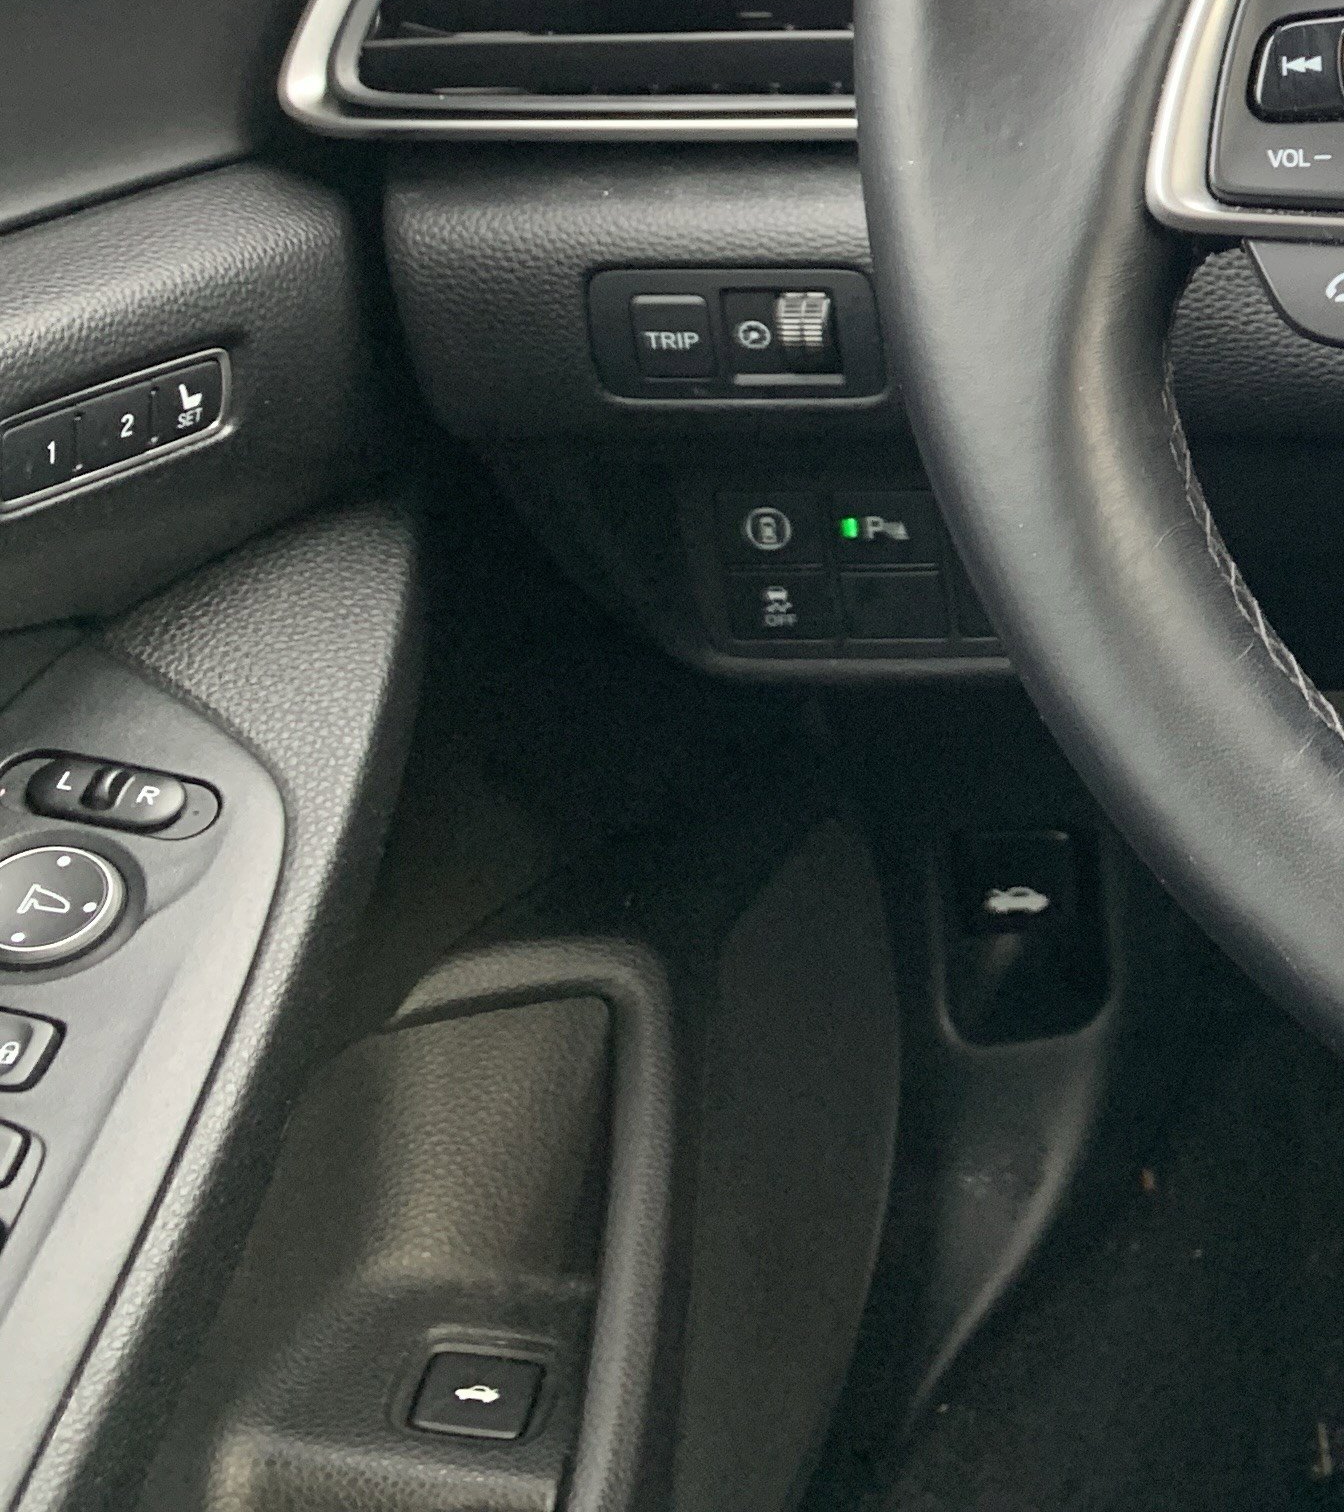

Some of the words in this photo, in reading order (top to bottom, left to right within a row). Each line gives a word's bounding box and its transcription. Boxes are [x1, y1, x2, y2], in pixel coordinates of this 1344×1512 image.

[645, 330, 700, 351] TRIP
[120, 414, 135, 438] 2
[177, 408, 203, 429] SET
[47, 441, 56, 464] 1
[764, 613, 797, 628] OFF
[57, 771, 72, 790] L
[136, 785, 160, 805] R
